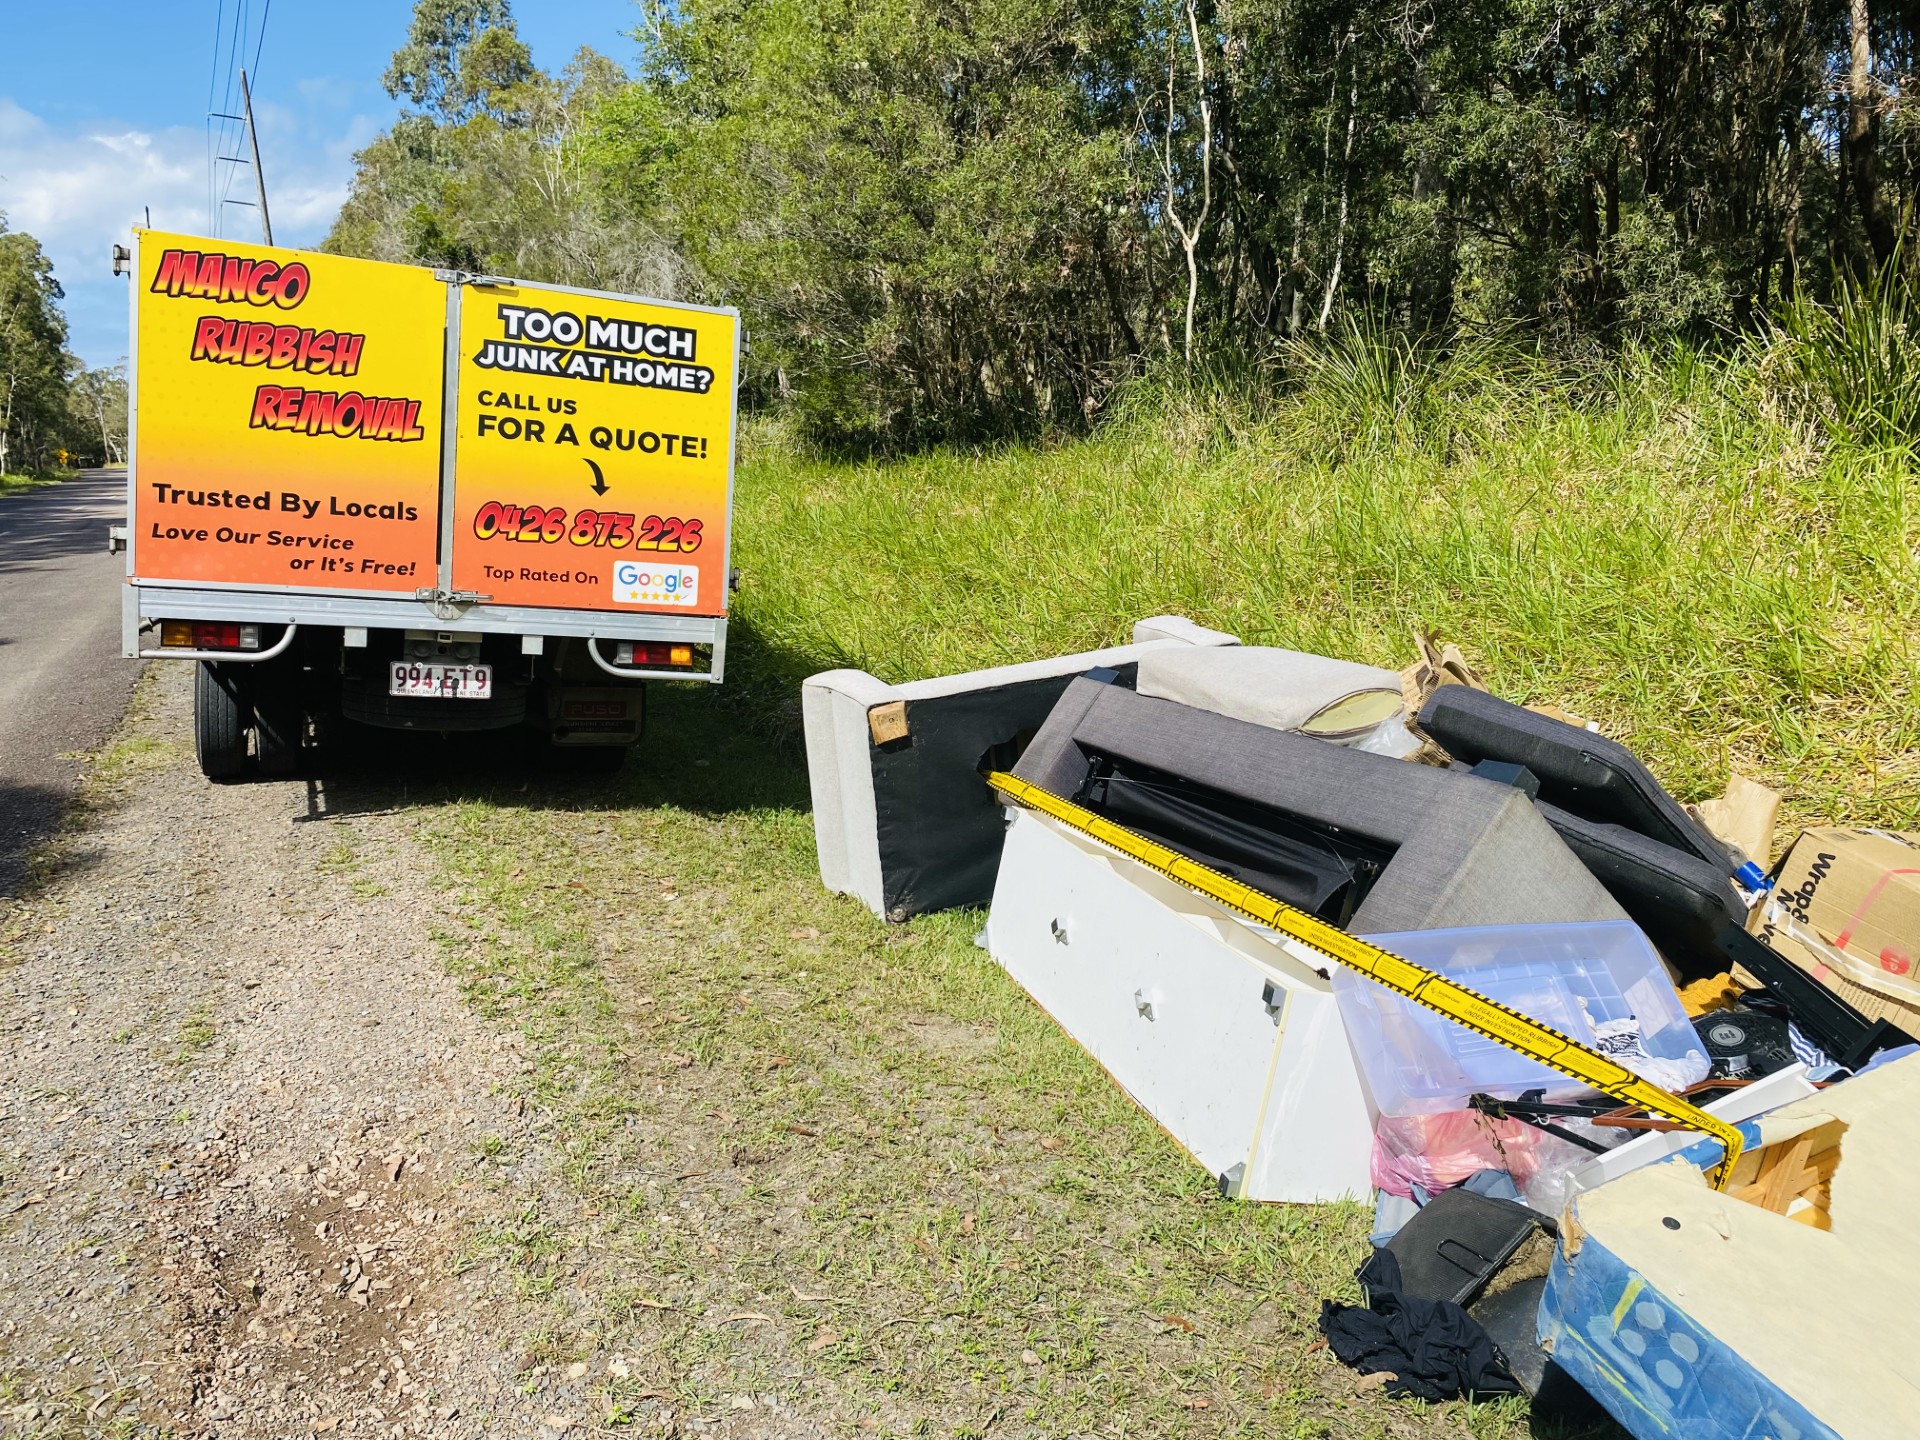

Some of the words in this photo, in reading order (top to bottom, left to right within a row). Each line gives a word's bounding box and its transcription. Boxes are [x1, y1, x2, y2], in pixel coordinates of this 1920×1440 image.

[151, 250, 310, 309] MANGO
[191, 316, 365, 376] RUBBISH
[499, 304, 583, 345] TOO
[586, 316, 697, 360] MUCH
[475, 342, 563, 375] JUNK
[566, 350, 607, 381] AT
[610, 359, 713, 393] HOME?
[250, 385, 424, 441] REMOVAL
[477, 390, 540, 411] CALL
[547, 397, 577, 415] US
[477, 414, 545, 443] FOR
[554, 423, 580, 446] A
[589, 426, 708, 459] QUOTE!
[152, 482, 271, 510] Trusted
[281, 493, 321, 519] By
[329, 496, 418, 521] Locals
[151, 523, 208, 542] Love
[215, 527, 261, 545] Our
[266, 530, 354, 550] Service
[473, 501, 567, 543] 0426
[569, 509, 635, 549] 873
[636, 515, 703, 553] 226
[290, 558, 315, 571] or
[320, 557, 354, 573] It's
[361, 559, 416, 576] Free!
[484, 565, 514, 582] Top
[520, 567, 570, 583] Rated
[574, 571, 599, 585] On
[618, 565, 694, 593] Google
[571, 704, 621, 715] FUSO
[1757, 888, 1795, 946] Mve
[1464, 1009, 1485, 1024] UNDER
[1484, 1018, 1532, 1044] INVESTIGATION
[1470, 1003, 1501, 1021] ILLEGALLY
[1500, 1017, 1529, 1034] DUMPED
[1528, 1031, 1559, 1049] RUBBISH
